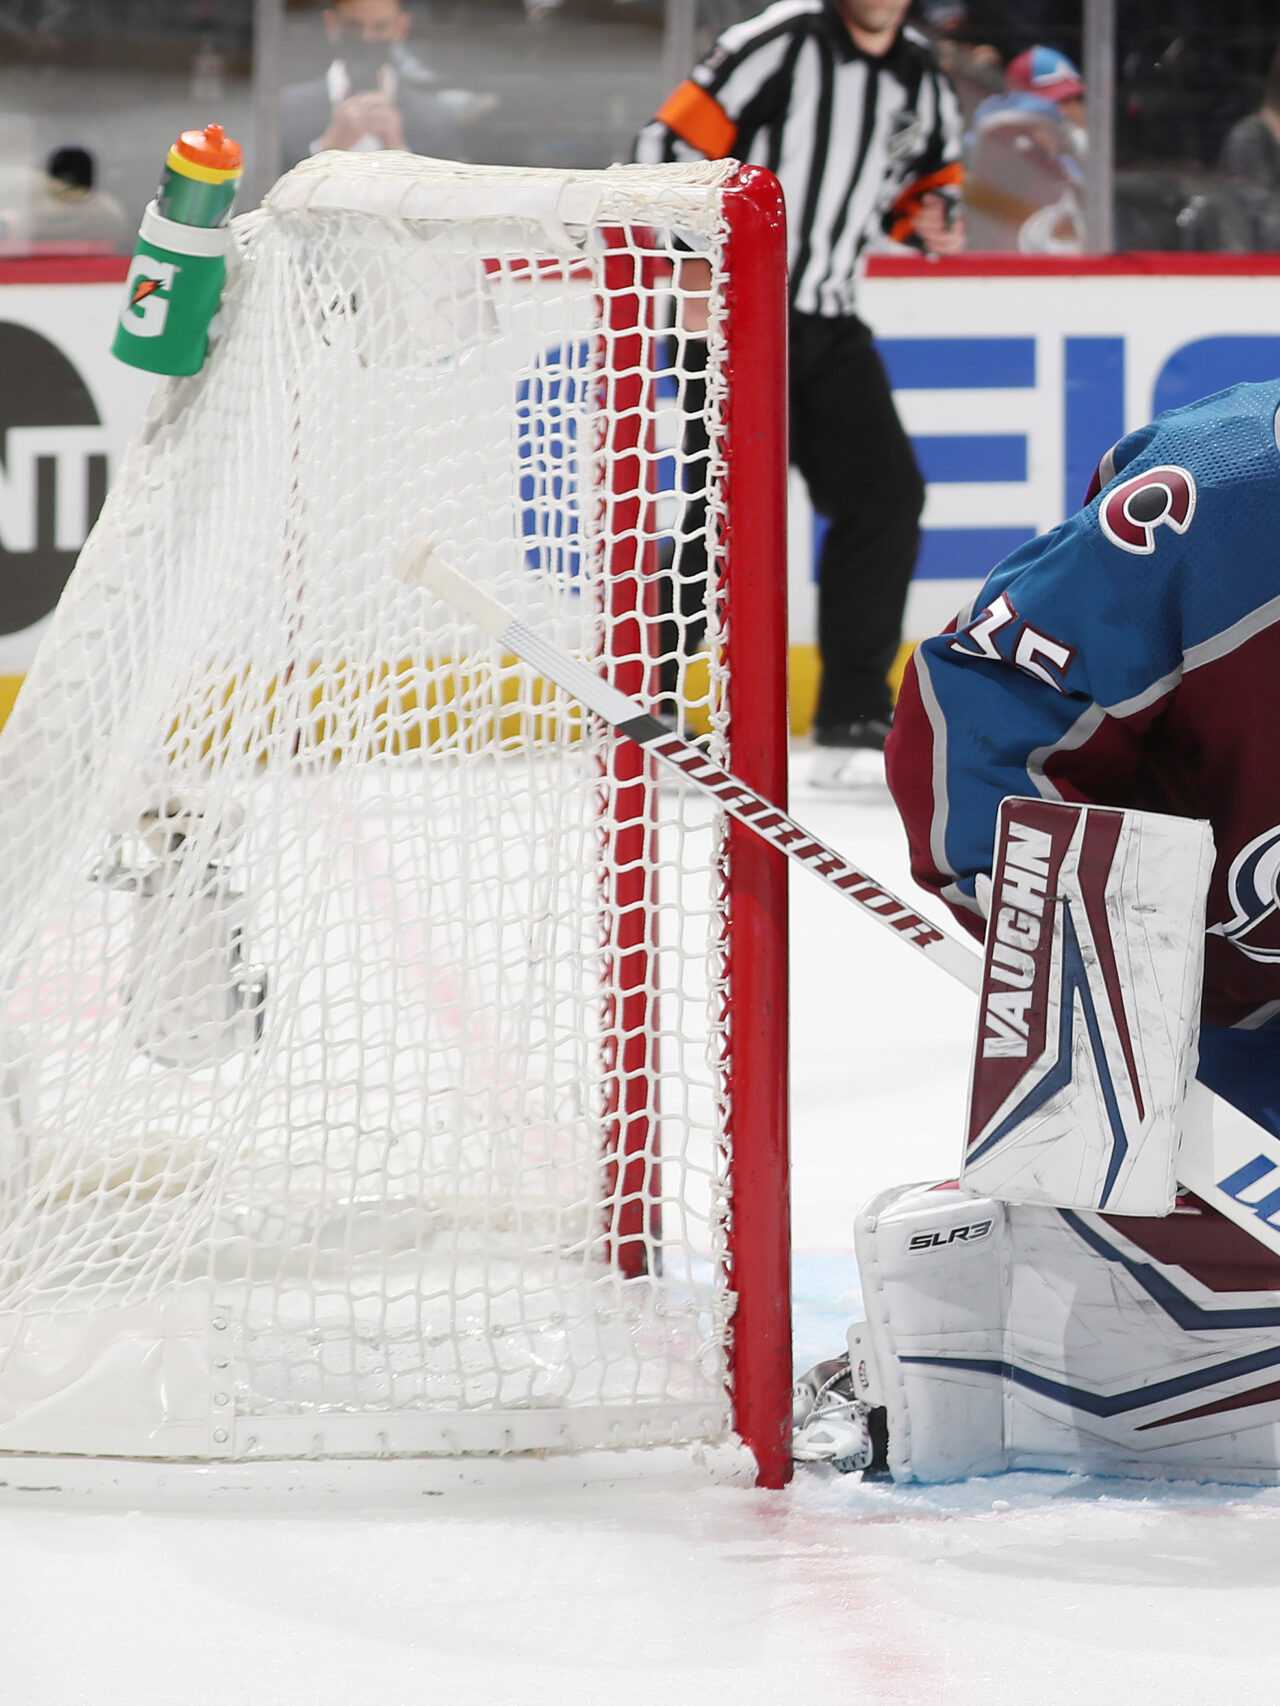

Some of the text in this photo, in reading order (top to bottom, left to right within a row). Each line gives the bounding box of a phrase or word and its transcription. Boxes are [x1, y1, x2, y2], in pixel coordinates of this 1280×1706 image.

[653, 739, 945, 949] WARRIOR
[982, 820, 1053, 1059] VAUGHN
[908, 1220, 993, 1250] SLR3
